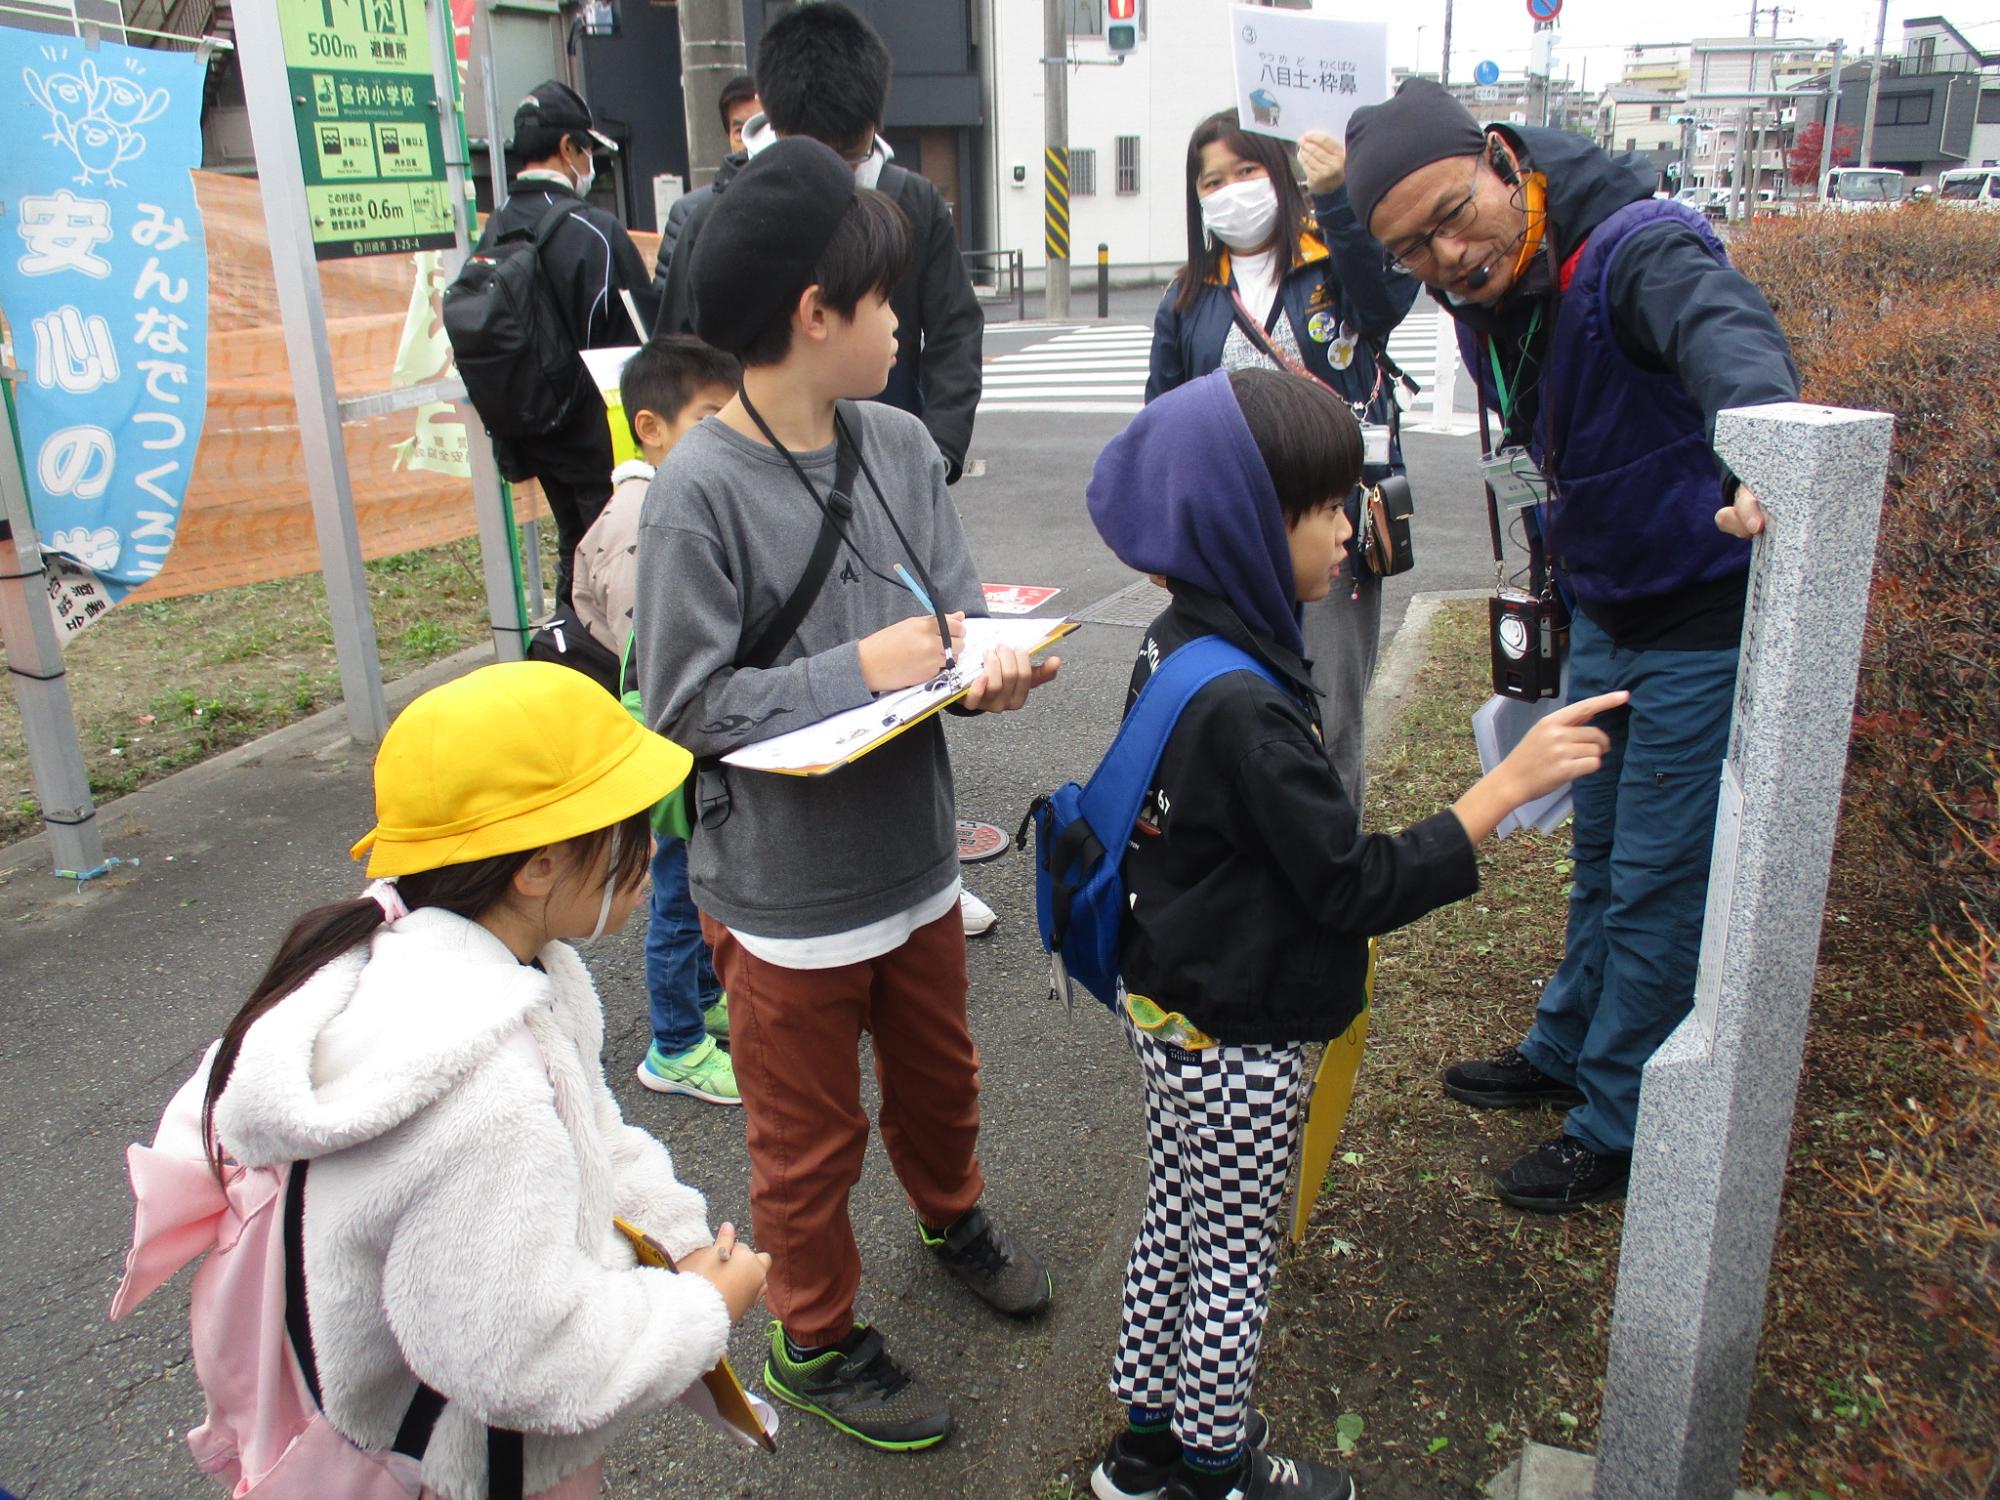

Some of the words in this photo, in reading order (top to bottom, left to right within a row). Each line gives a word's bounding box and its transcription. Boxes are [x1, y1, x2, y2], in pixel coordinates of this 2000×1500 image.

[307, 32, 358, 59] 500m
[370, 39, 407, 59] 避難所
[339, 83, 415, 106] 宮内小学校
[368, 199, 404, 220] 0.6m
